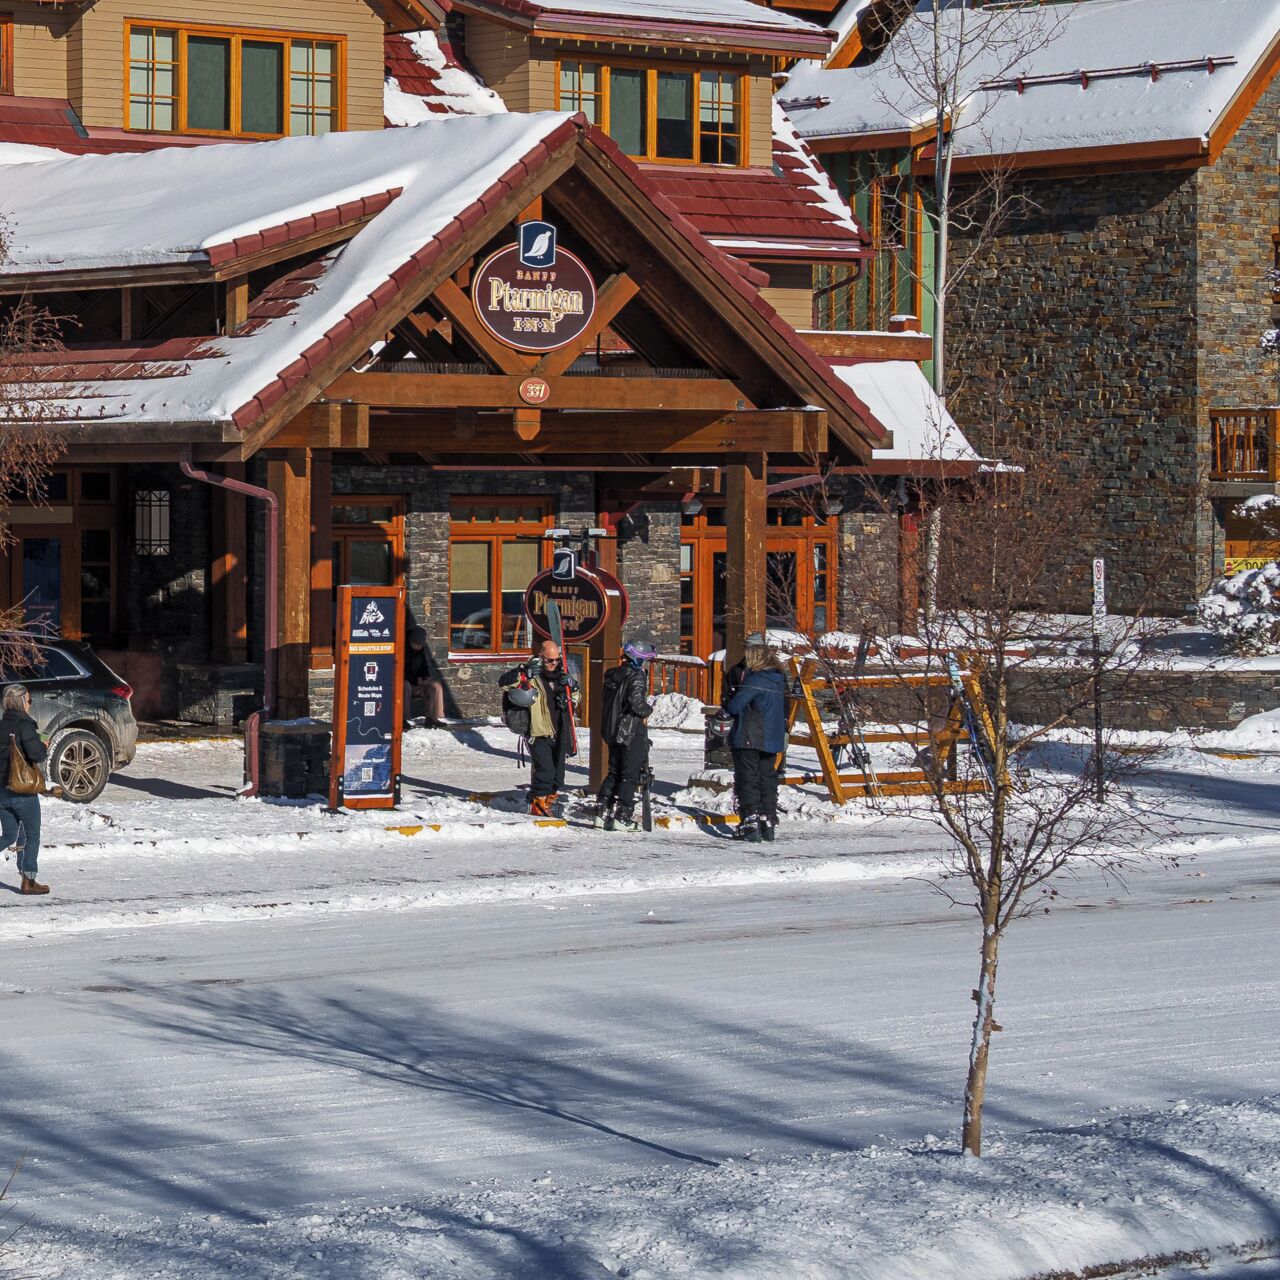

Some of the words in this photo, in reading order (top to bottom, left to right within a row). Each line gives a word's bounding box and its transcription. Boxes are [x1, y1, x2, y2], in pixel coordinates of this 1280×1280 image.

[516, 270, 557, 282] BANFF
[489, 277, 584, 323] Ptarmigan
[526, 383, 546, 398] 337
